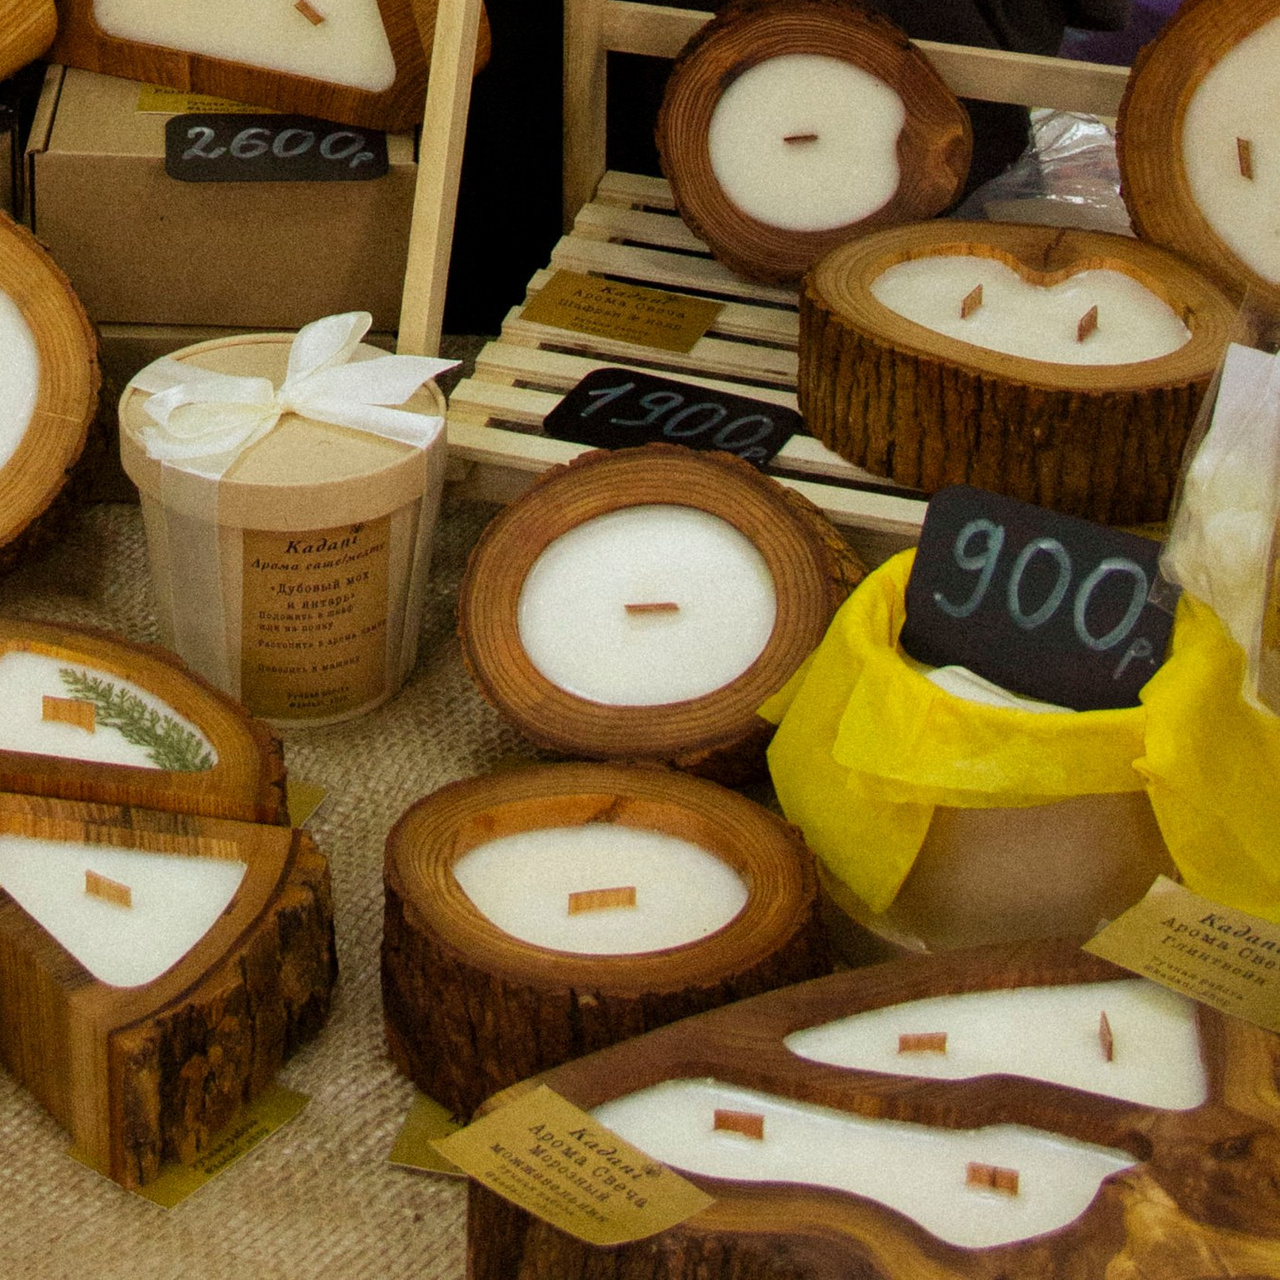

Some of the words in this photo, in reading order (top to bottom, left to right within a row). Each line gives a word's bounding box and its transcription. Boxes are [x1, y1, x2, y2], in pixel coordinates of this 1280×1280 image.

[572, 289, 627, 308] Арома
[635, 302, 685, 319] Свеча
[250, 557, 300, 572] Арома
[346, 571, 370, 586] мох
[287, 602, 295, 610] и
[1160, 916, 1229, 951] Арома
[1238, 946, 1280, 971] Све
[1199, 912, 1280, 954] Kadan
[1161, 934, 1267, 987] Глинтвейн
[490, 1142, 610, 1223] можжевельник
[528, 1123, 588, 1168] Арома
[592, 1165, 650, 1209] Свеча
[528, 1144, 611, 1203] Морозный
